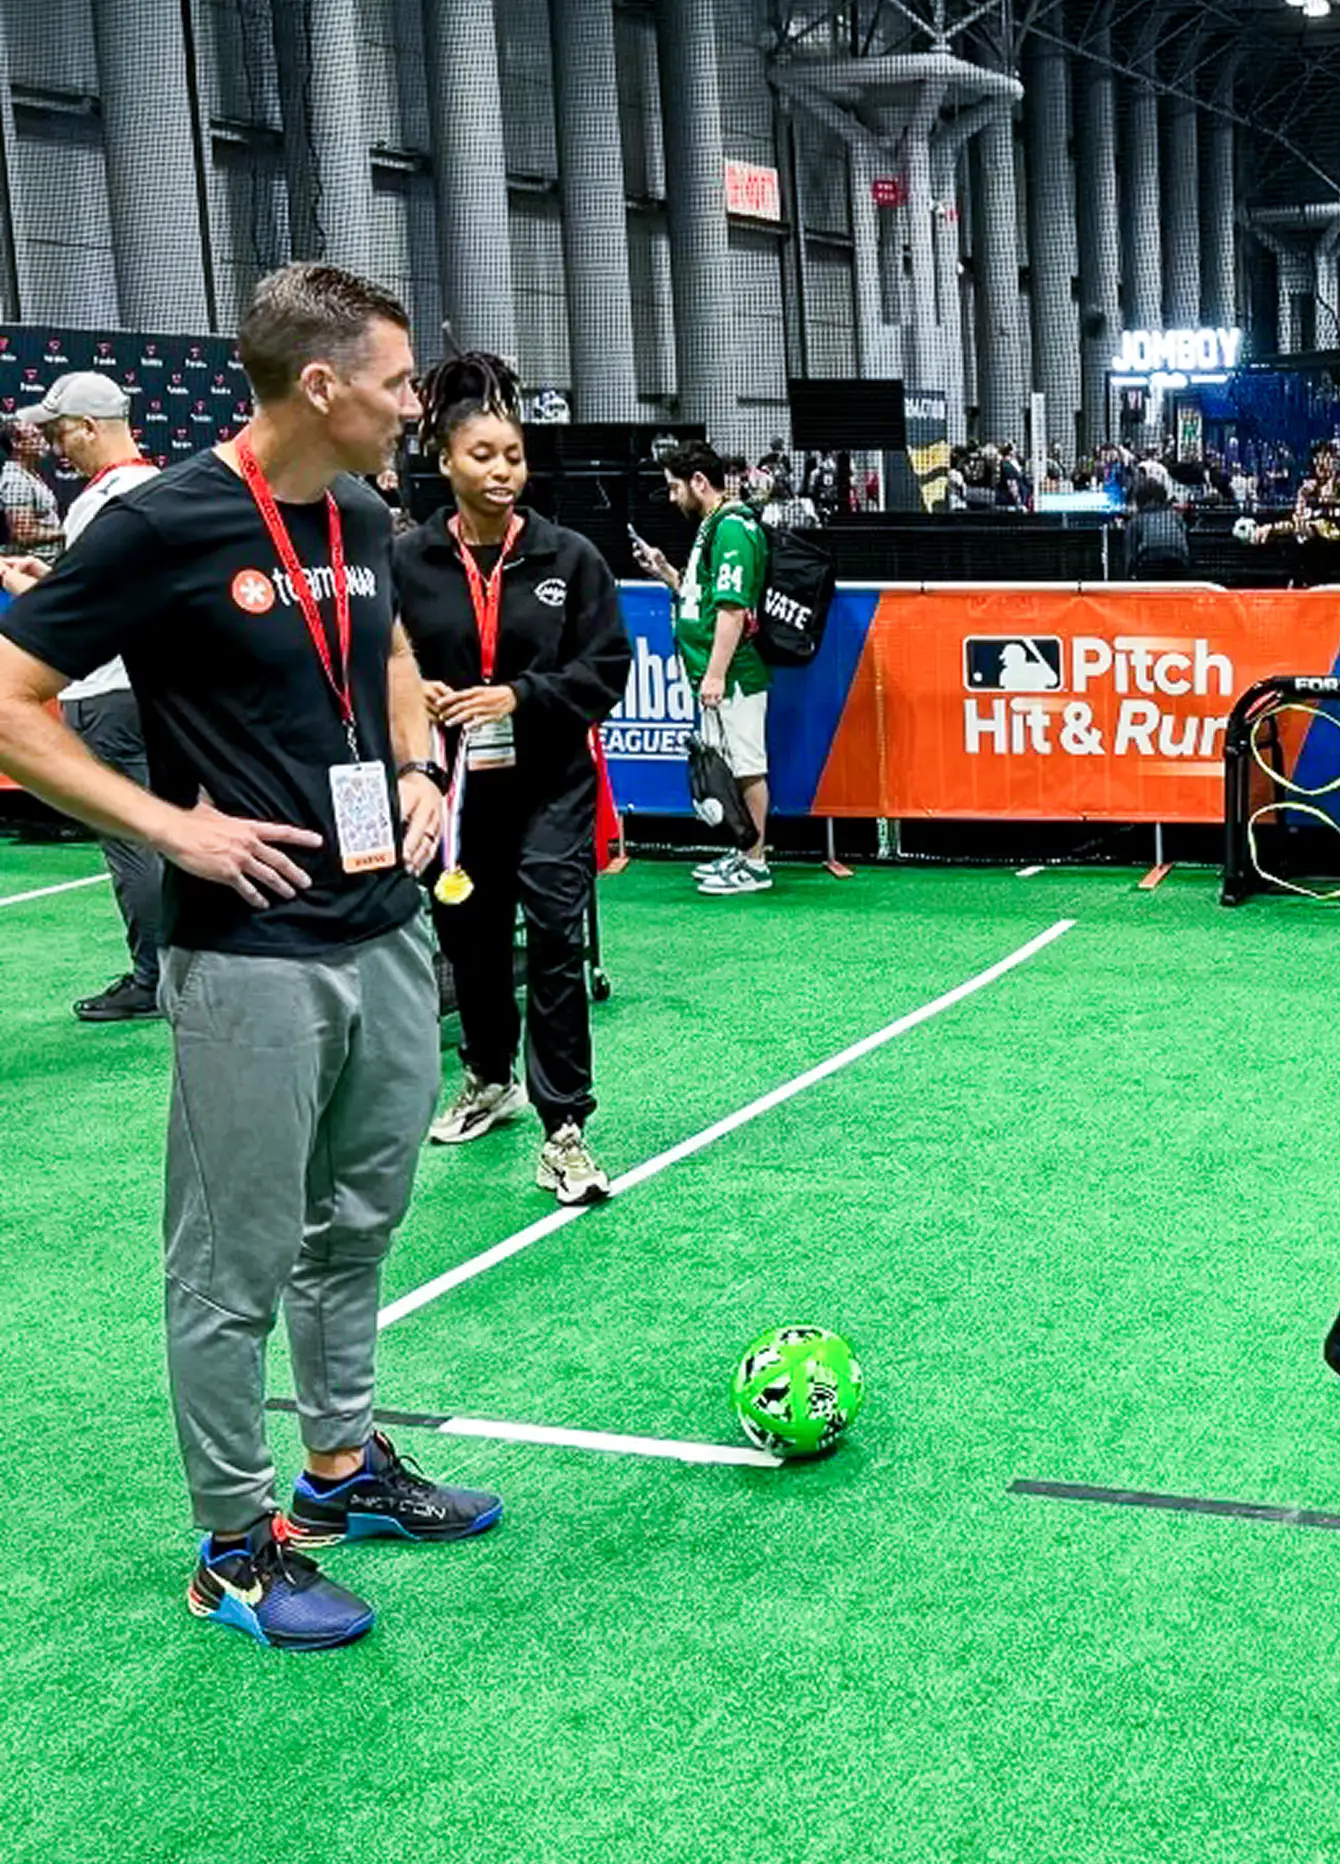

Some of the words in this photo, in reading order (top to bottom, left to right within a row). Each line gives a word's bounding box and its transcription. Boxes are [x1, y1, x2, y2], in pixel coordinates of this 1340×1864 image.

[1112, 327, 1241, 370] JOMBOY
[717, 562, 744, 593] 84
[1072, 637, 1233, 696] Pitch
[964, 698, 1052, 755] Hit
[1060, 701, 1105, 756] &
